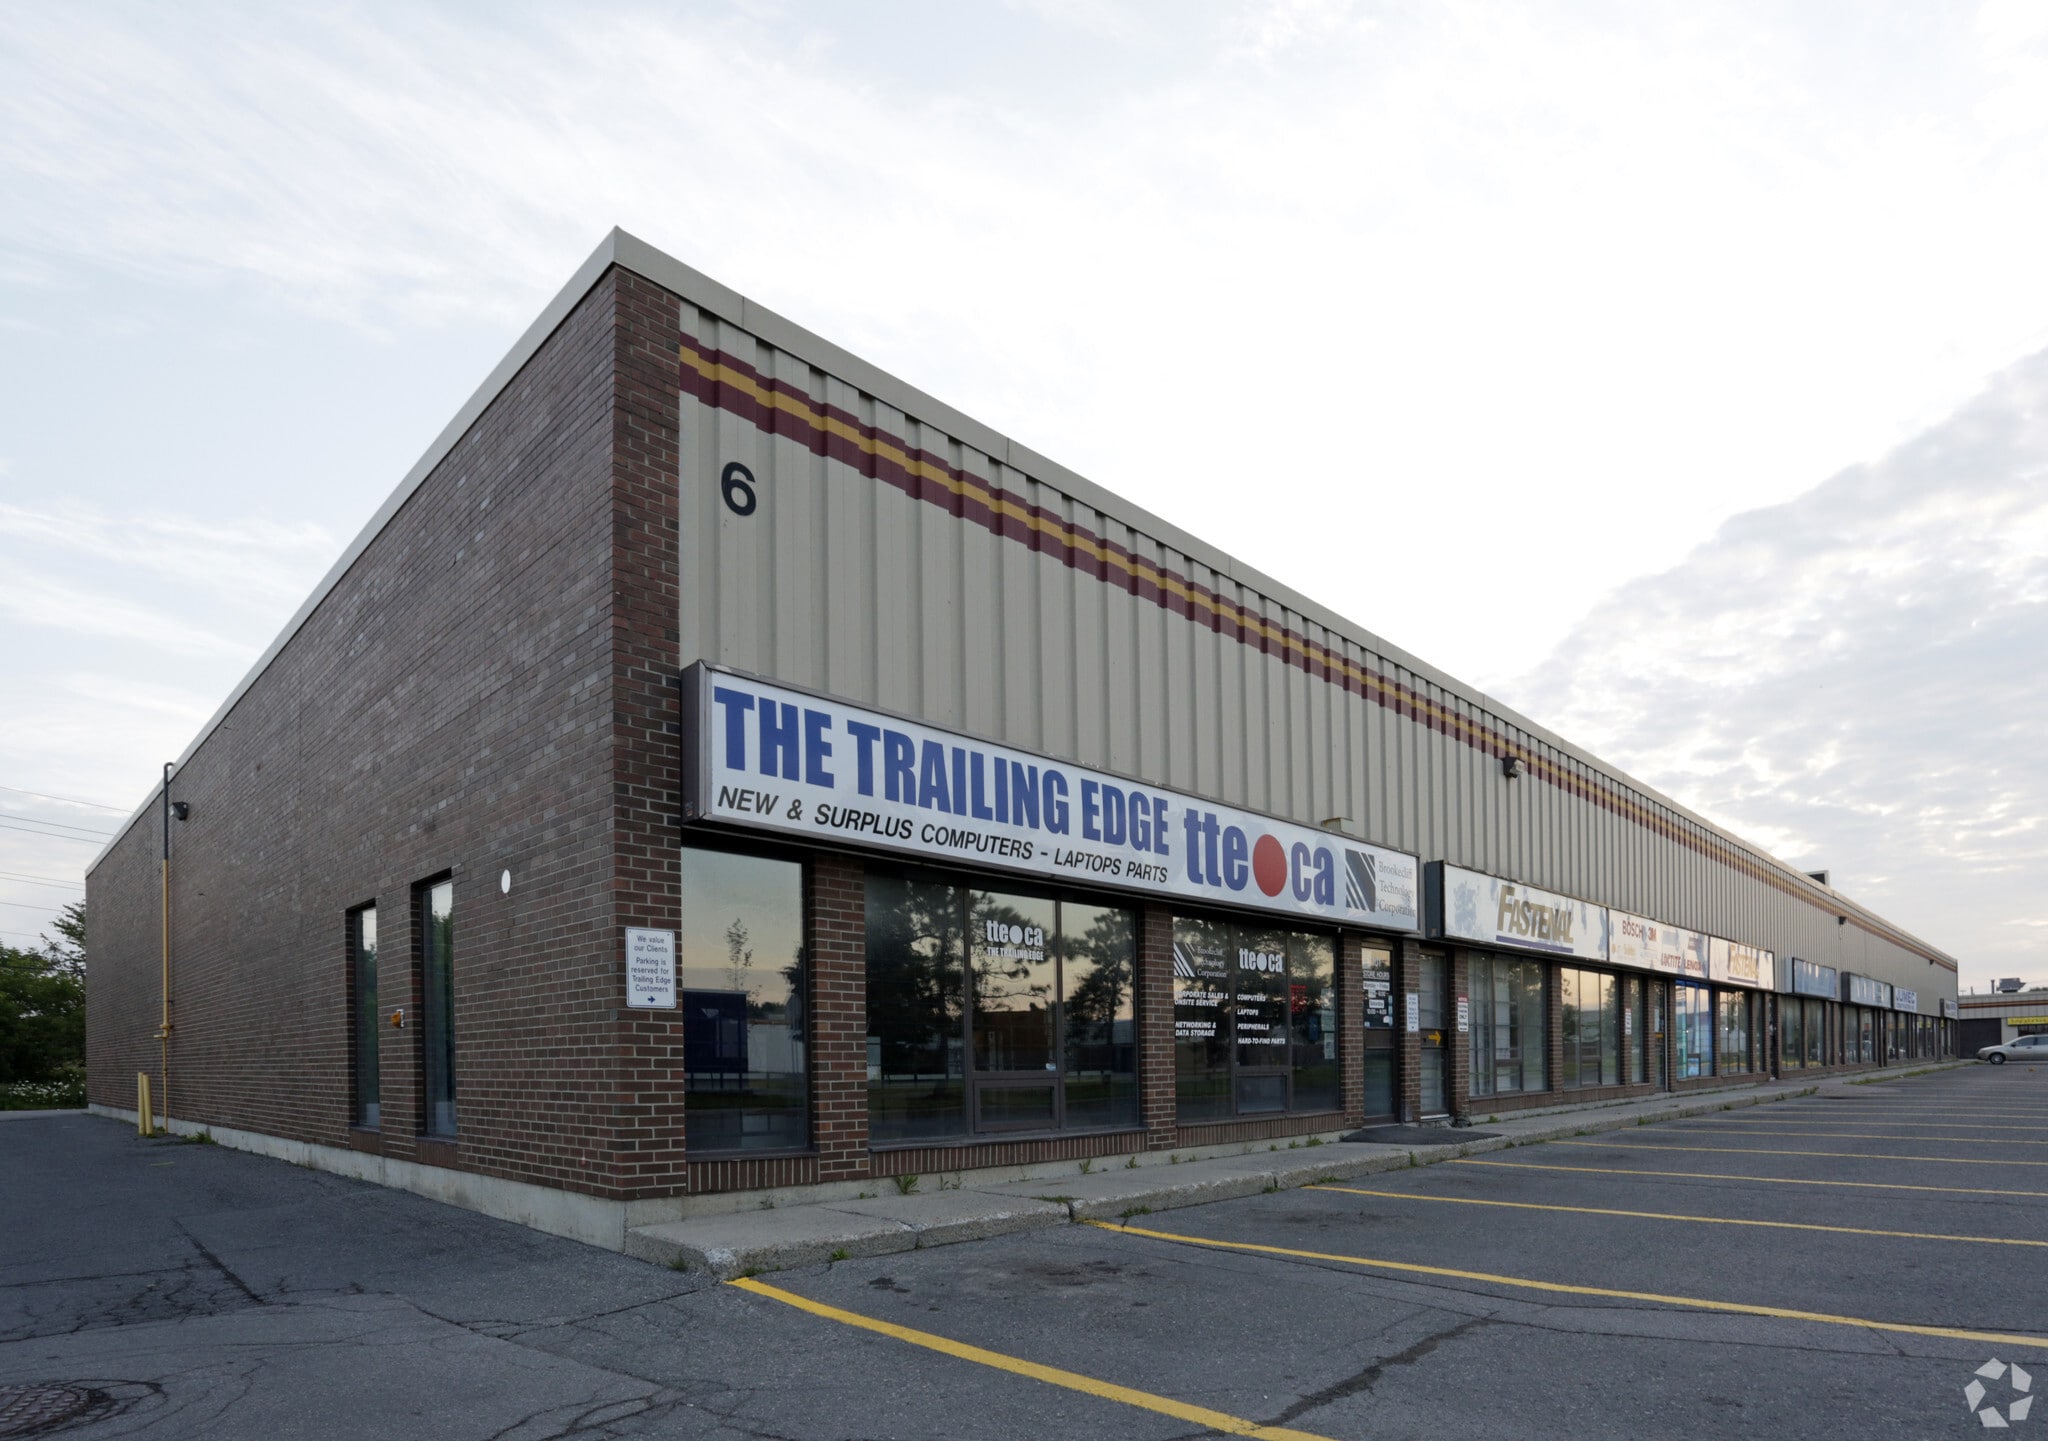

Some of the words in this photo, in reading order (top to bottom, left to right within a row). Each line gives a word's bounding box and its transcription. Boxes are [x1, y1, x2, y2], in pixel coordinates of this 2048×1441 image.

[721, 462, 756, 516] 6
[714, 686, 834, 789] THE
[847, 719, 1070, 836] TRAILING
[1081, 778, 1169, 856] EDGE
[718, 785, 779, 815] NEW
[787, 799, 802, 821] &
[815, 804, 913, 839] SURPLUS
[921, 823, 1034, 860] COMPUTERS
[1054, 848, 1121, 876] LAPTOPS
[1126, 861, 1168, 883] PARTS
[1497, 884, 1574, 943] FASTENAL
[1622, 920, 1643, 938] BOSCH
[637, 935, 646, 943] We
[646, 945, 668, 953] Clients
[987, 946, 999, 957] THE
[1000, 947, 1028, 960] TRAILING
[1029, 950, 1044, 960] EDGE
[636, 957, 658, 966] Parking
[660, 967, 669, 975] for
[632, 975, 653, 984] Trailing
[655, 976, 671, 985] Edge
[635, 984, 668, 992] Customers
[1237, 1008, 1259, 1016] LAPTOPS
